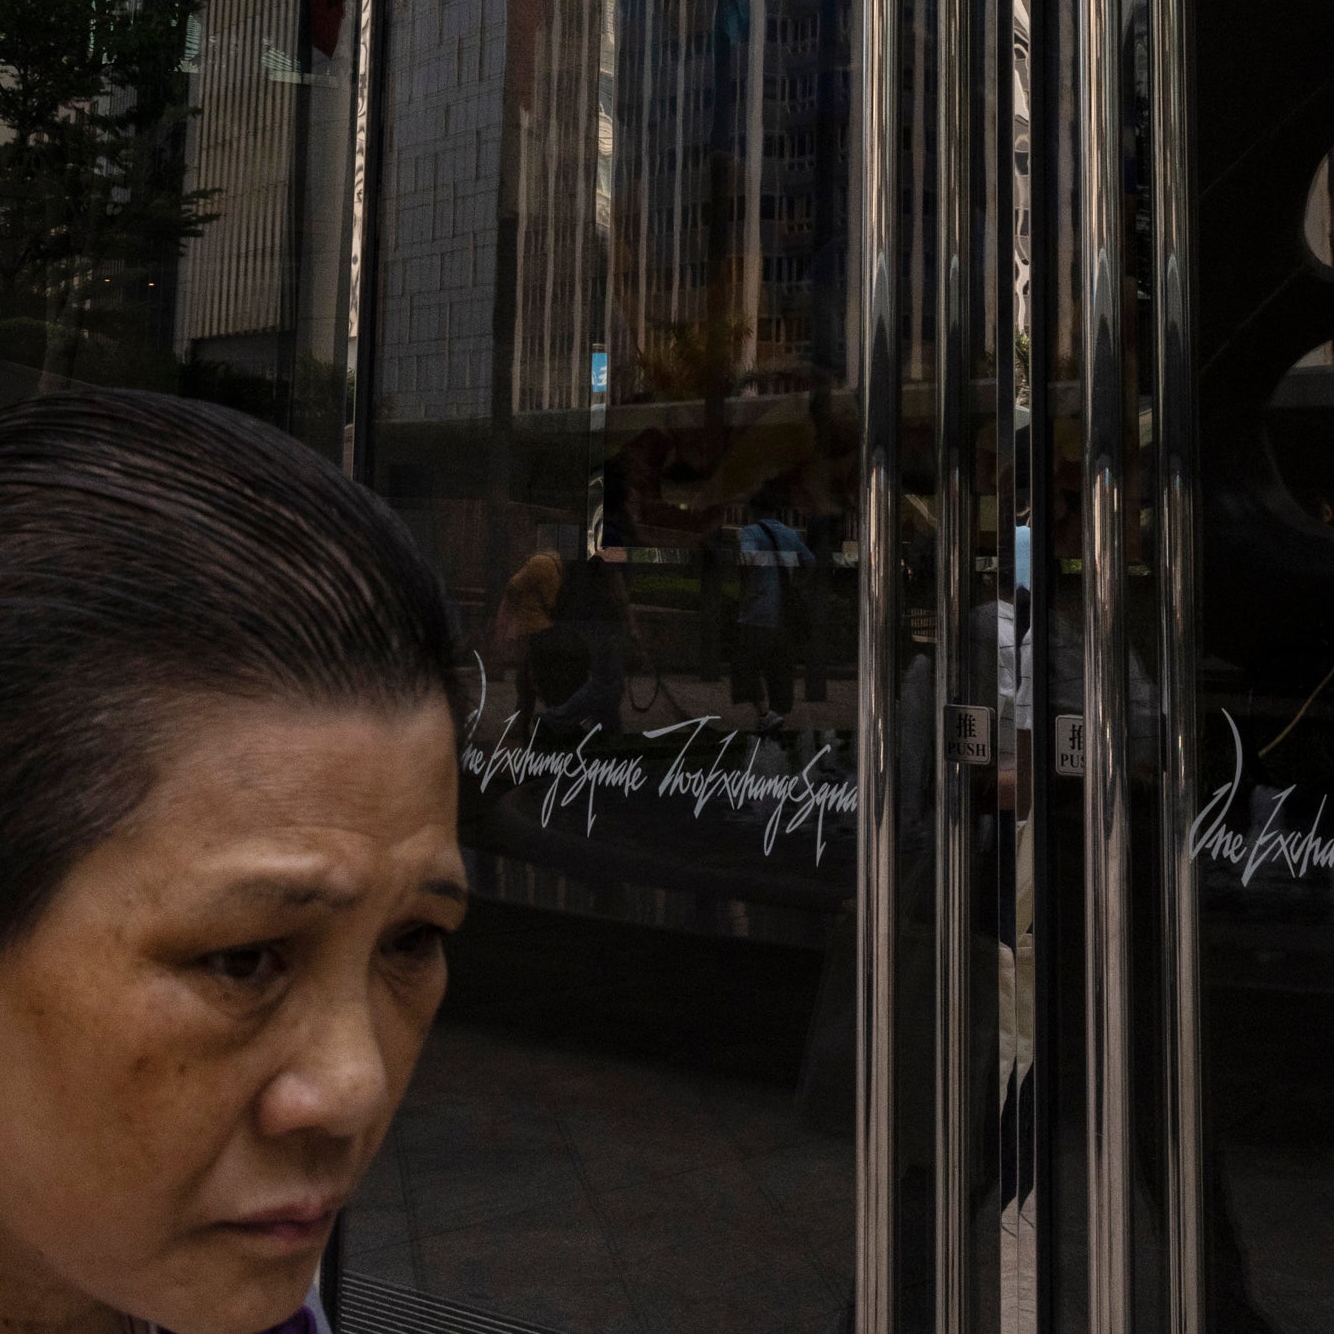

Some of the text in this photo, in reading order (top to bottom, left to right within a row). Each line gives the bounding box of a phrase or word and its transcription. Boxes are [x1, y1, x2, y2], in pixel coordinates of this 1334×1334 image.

[948, 741, 987, 758] PUSH
[956, 713, 977, 739] 推
[561, 723, 647, 838] Square
[642, 716, 721, 797] Two
[786, 745, 858, 866] Squa
[1189, 708, 1247, 863] One
